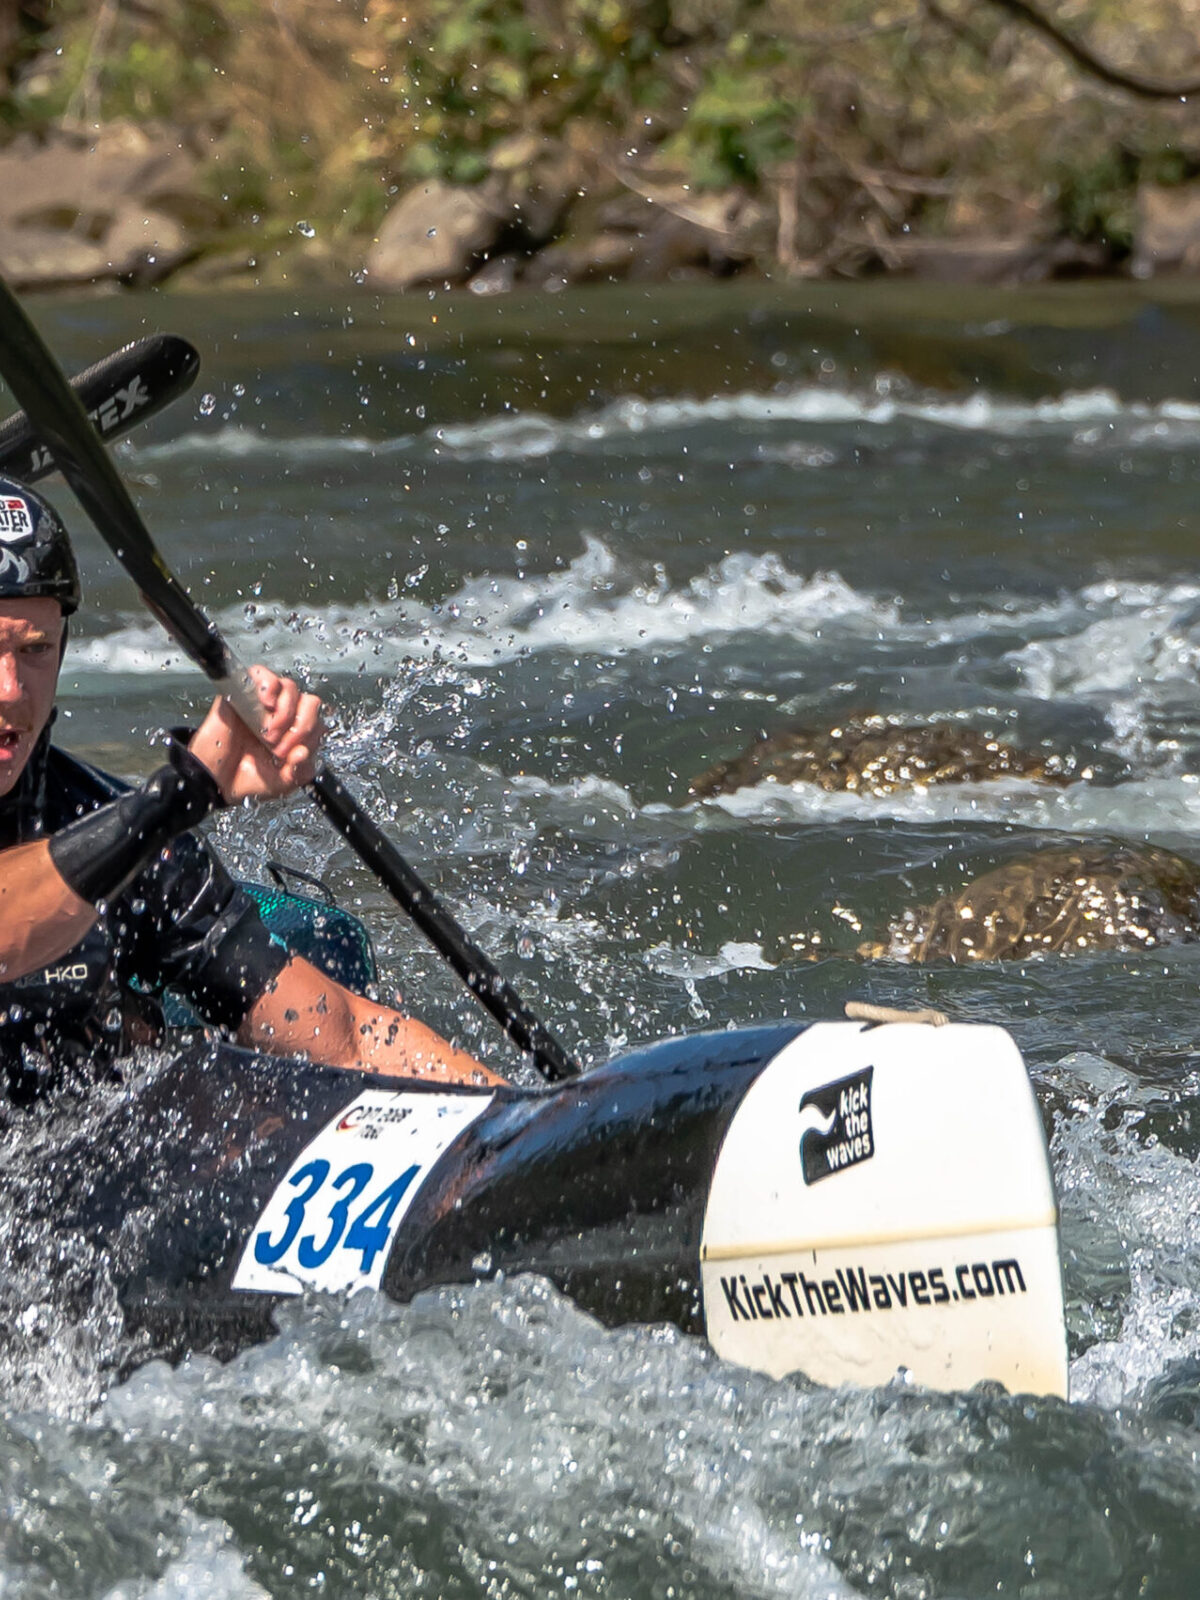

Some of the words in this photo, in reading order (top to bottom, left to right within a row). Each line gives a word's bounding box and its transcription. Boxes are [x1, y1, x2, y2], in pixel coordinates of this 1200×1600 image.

[839, 1082, 868, 1118] kick
[845, 1111, 868, 1138] the
[826, 1133, 871, 1170] waves
[254, 1158, 422, 1275] 334
[720, 1257, 1027, 1321] KickTheWaves.com
